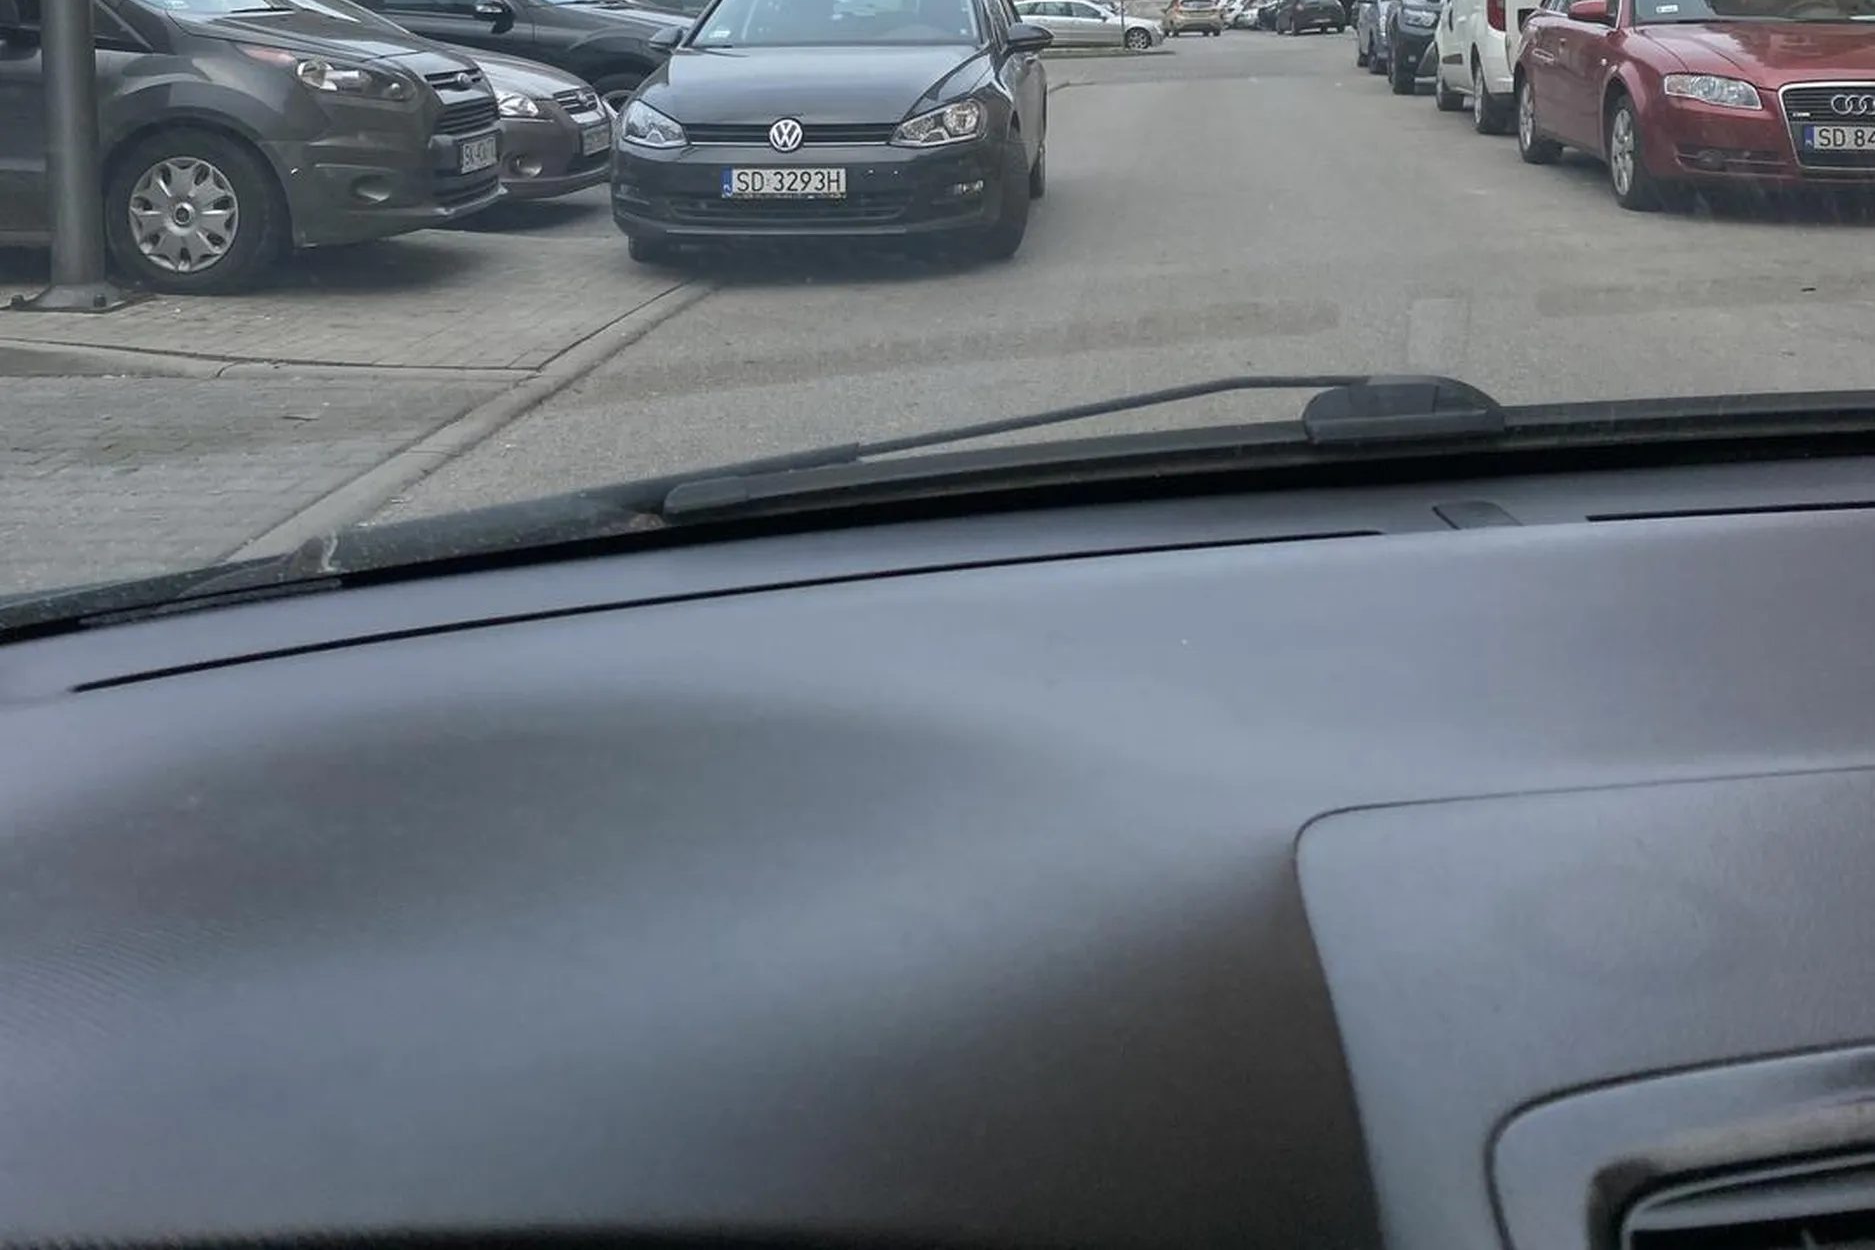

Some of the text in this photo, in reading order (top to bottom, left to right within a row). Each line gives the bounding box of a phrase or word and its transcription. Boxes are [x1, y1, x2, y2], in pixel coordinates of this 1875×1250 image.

[1818, 128, 1846, 147] SD
[737, 171, 840, 192] SD 3293H
